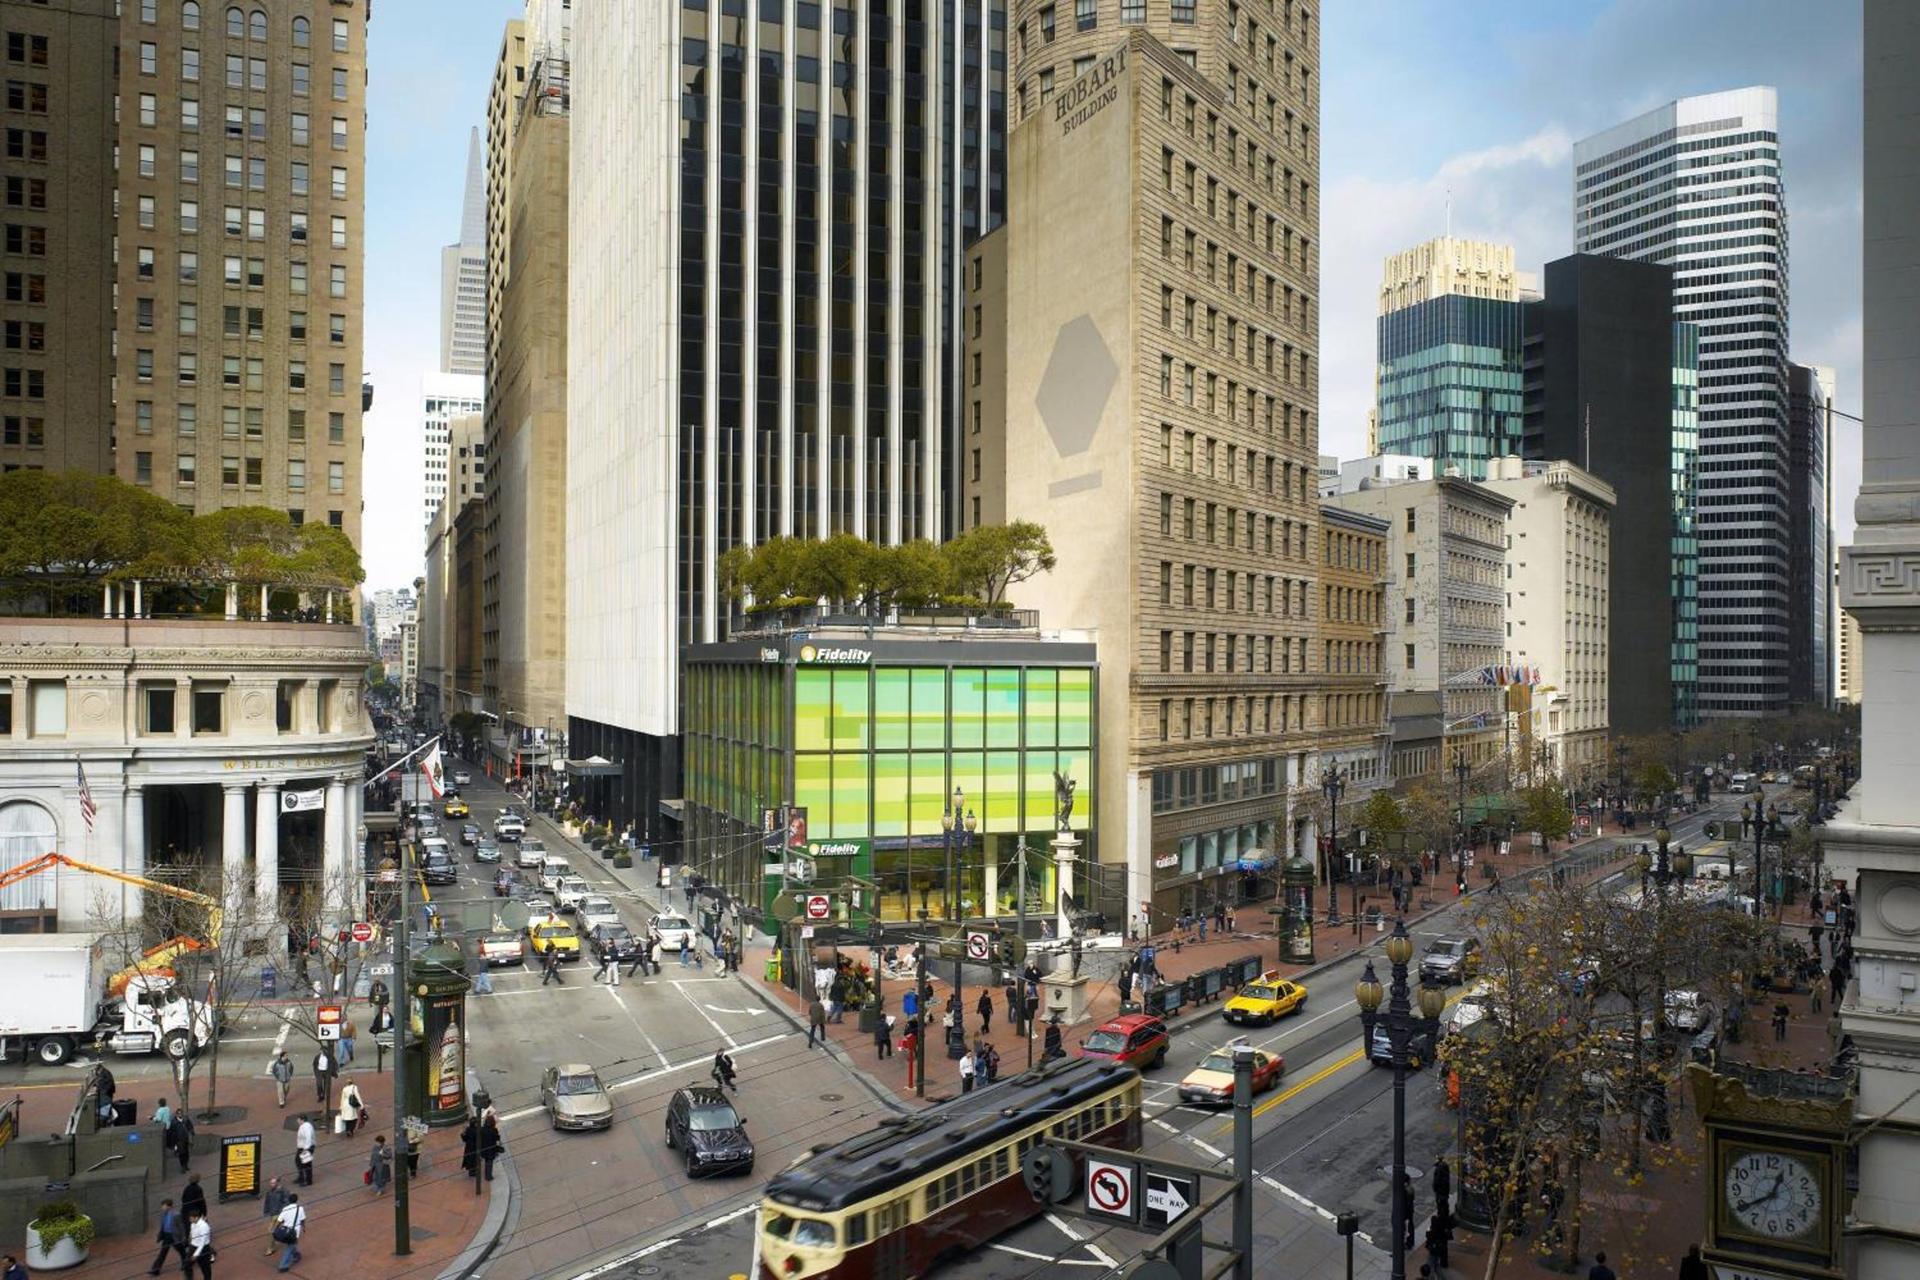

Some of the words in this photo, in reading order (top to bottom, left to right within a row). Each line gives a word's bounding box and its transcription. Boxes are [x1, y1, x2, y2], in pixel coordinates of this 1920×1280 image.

[1055, 45, 1127, 122] HOBART
[1063, 85, 1118, 136] BUILDING
[815, 648, 873, 664] Fidelity
[820, 843, 860, 855] Fidelity
[1749, 1158, 1760, 1171] 11
[1766, 1156, 1780, 1170] 12
[1788, 1163, 1794, 1176] 1
[1732, 1167, 1749, 1180] 10
[1732, 1183, 1741, 1196] 9
[1800, 1177, 1809, 1190] 2
[1148, 1194, 1165, 1206] ONE
[1169, 1200, 1186, 1209] WAY
[1805, 1193, 1815, 1208] 3
[1751, 1212, 1760, 1226] 7
[1785, 1218, 1796, 1232] 5
[1767, 1220, 1777, 1233] 6
